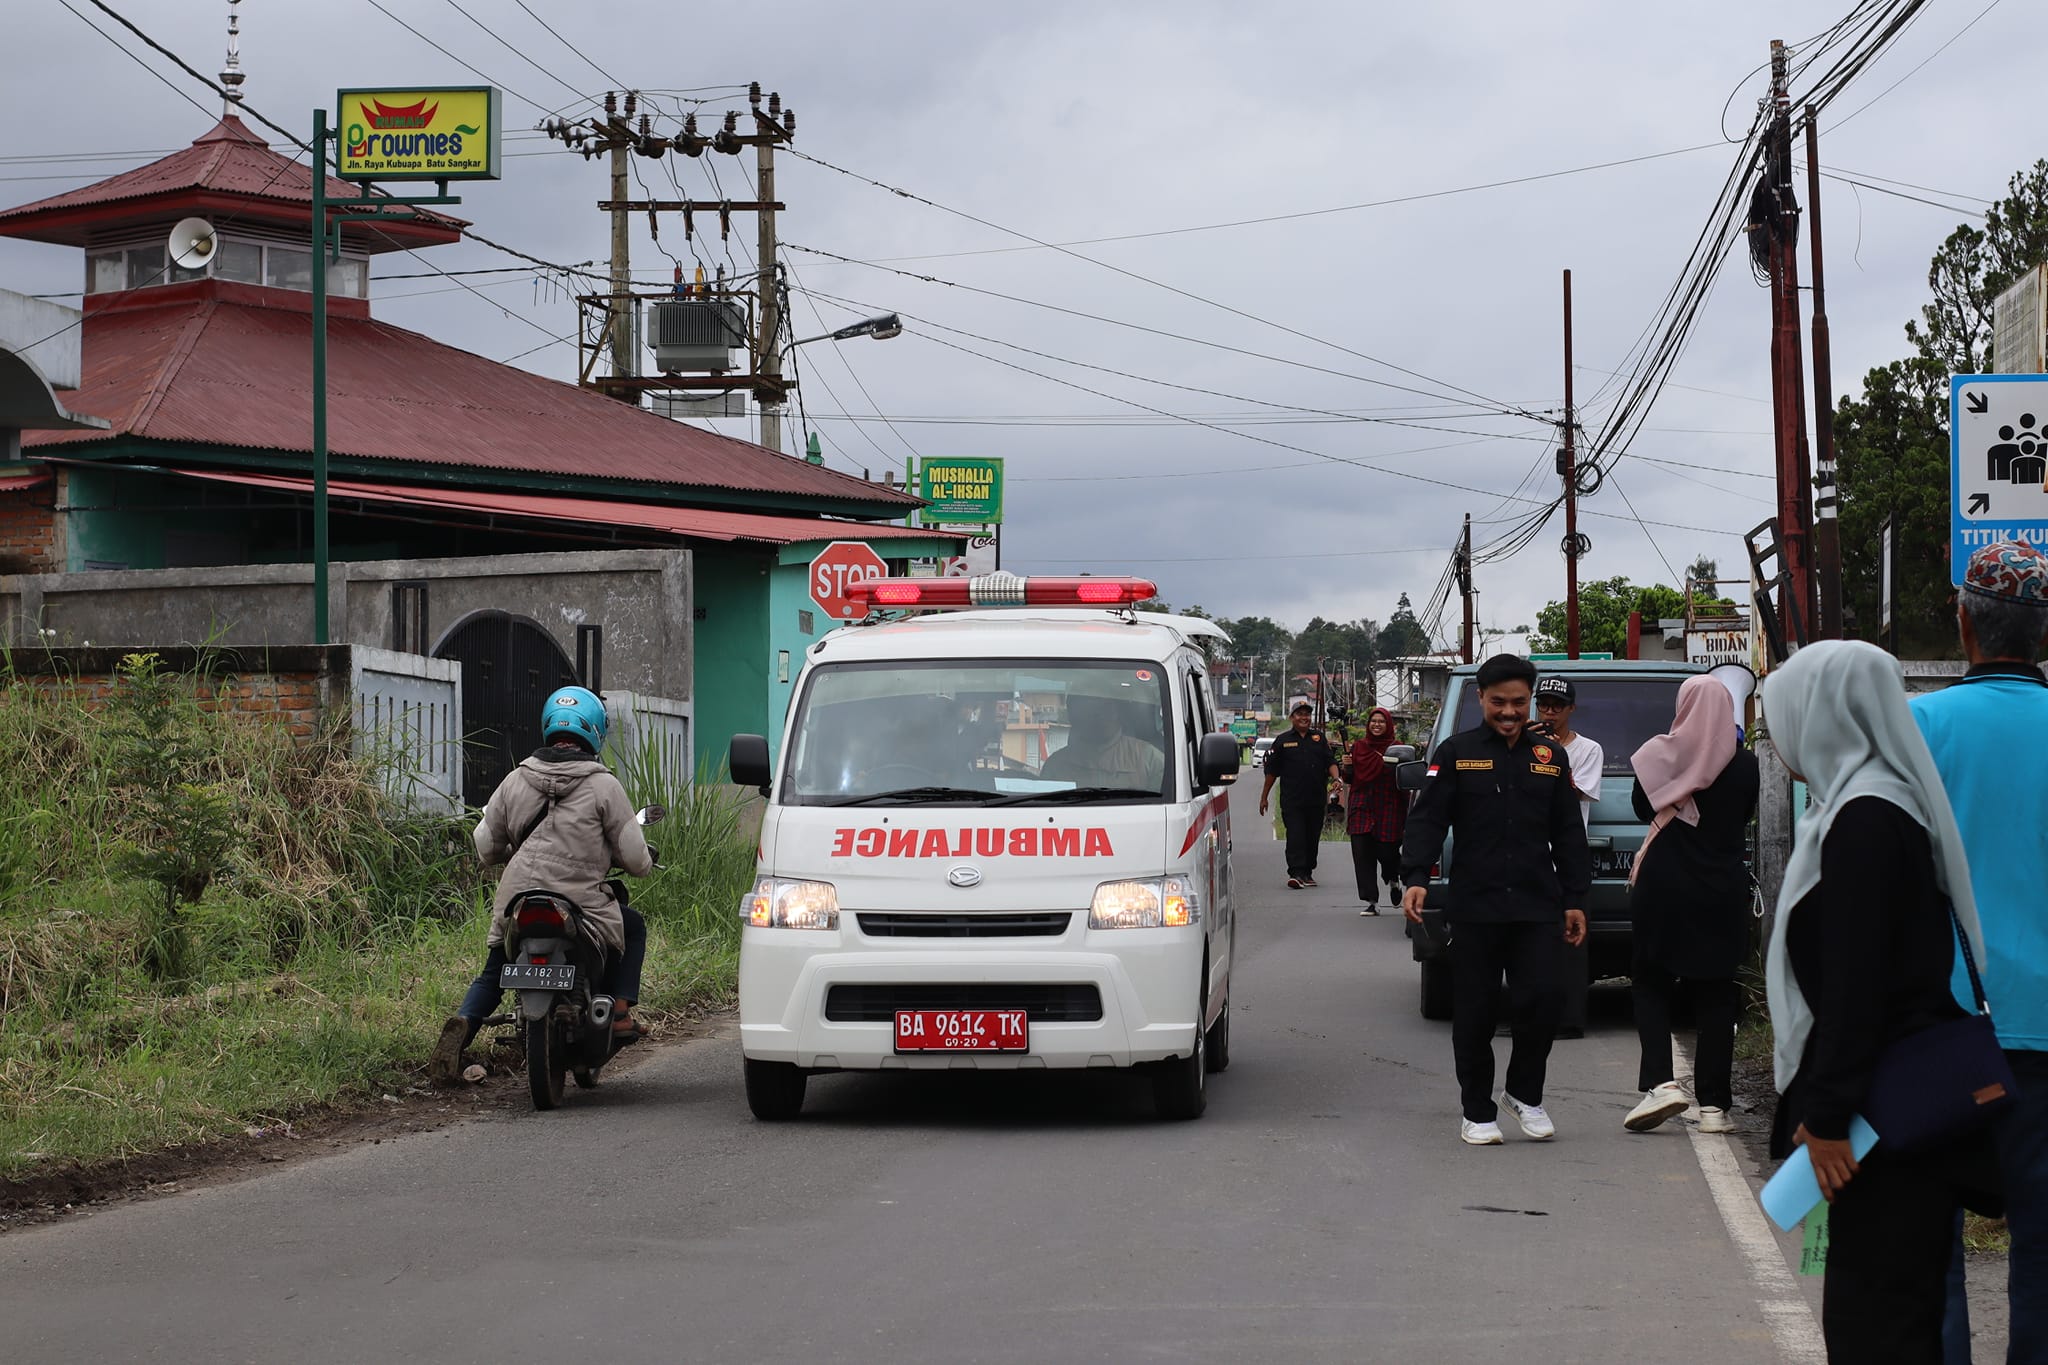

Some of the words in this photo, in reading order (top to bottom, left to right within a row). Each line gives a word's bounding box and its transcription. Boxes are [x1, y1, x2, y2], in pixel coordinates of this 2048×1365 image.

[375, 115, 425, 128] RUMAH
[347, 159, 362, 169] Jln.
[364, 160, 384, 170] Raya
[386, 159, 422, 170] Kubuapa
[426, 159, 446, 168] Batu
[447, 158, 481, 169] Sangkar
[928, 467, 994, 483] MUSHALLA
[932, 484, 989, 499] AL-IHSAN
[1960, 528, 2012, 545] TITIK
[2016, 528, 2048, 545] KU
[1706, 637, 1748, 652] BIDAN
[504, 966, 518, 976] BA
[525, 967, 553, 978] 4182
[559, 968, 573, 978] LV
[900, 1014, 925, 1036] BA
[935, 1013, 985, 1036] 9614
[998, 1013, 1022, 1036] TK
